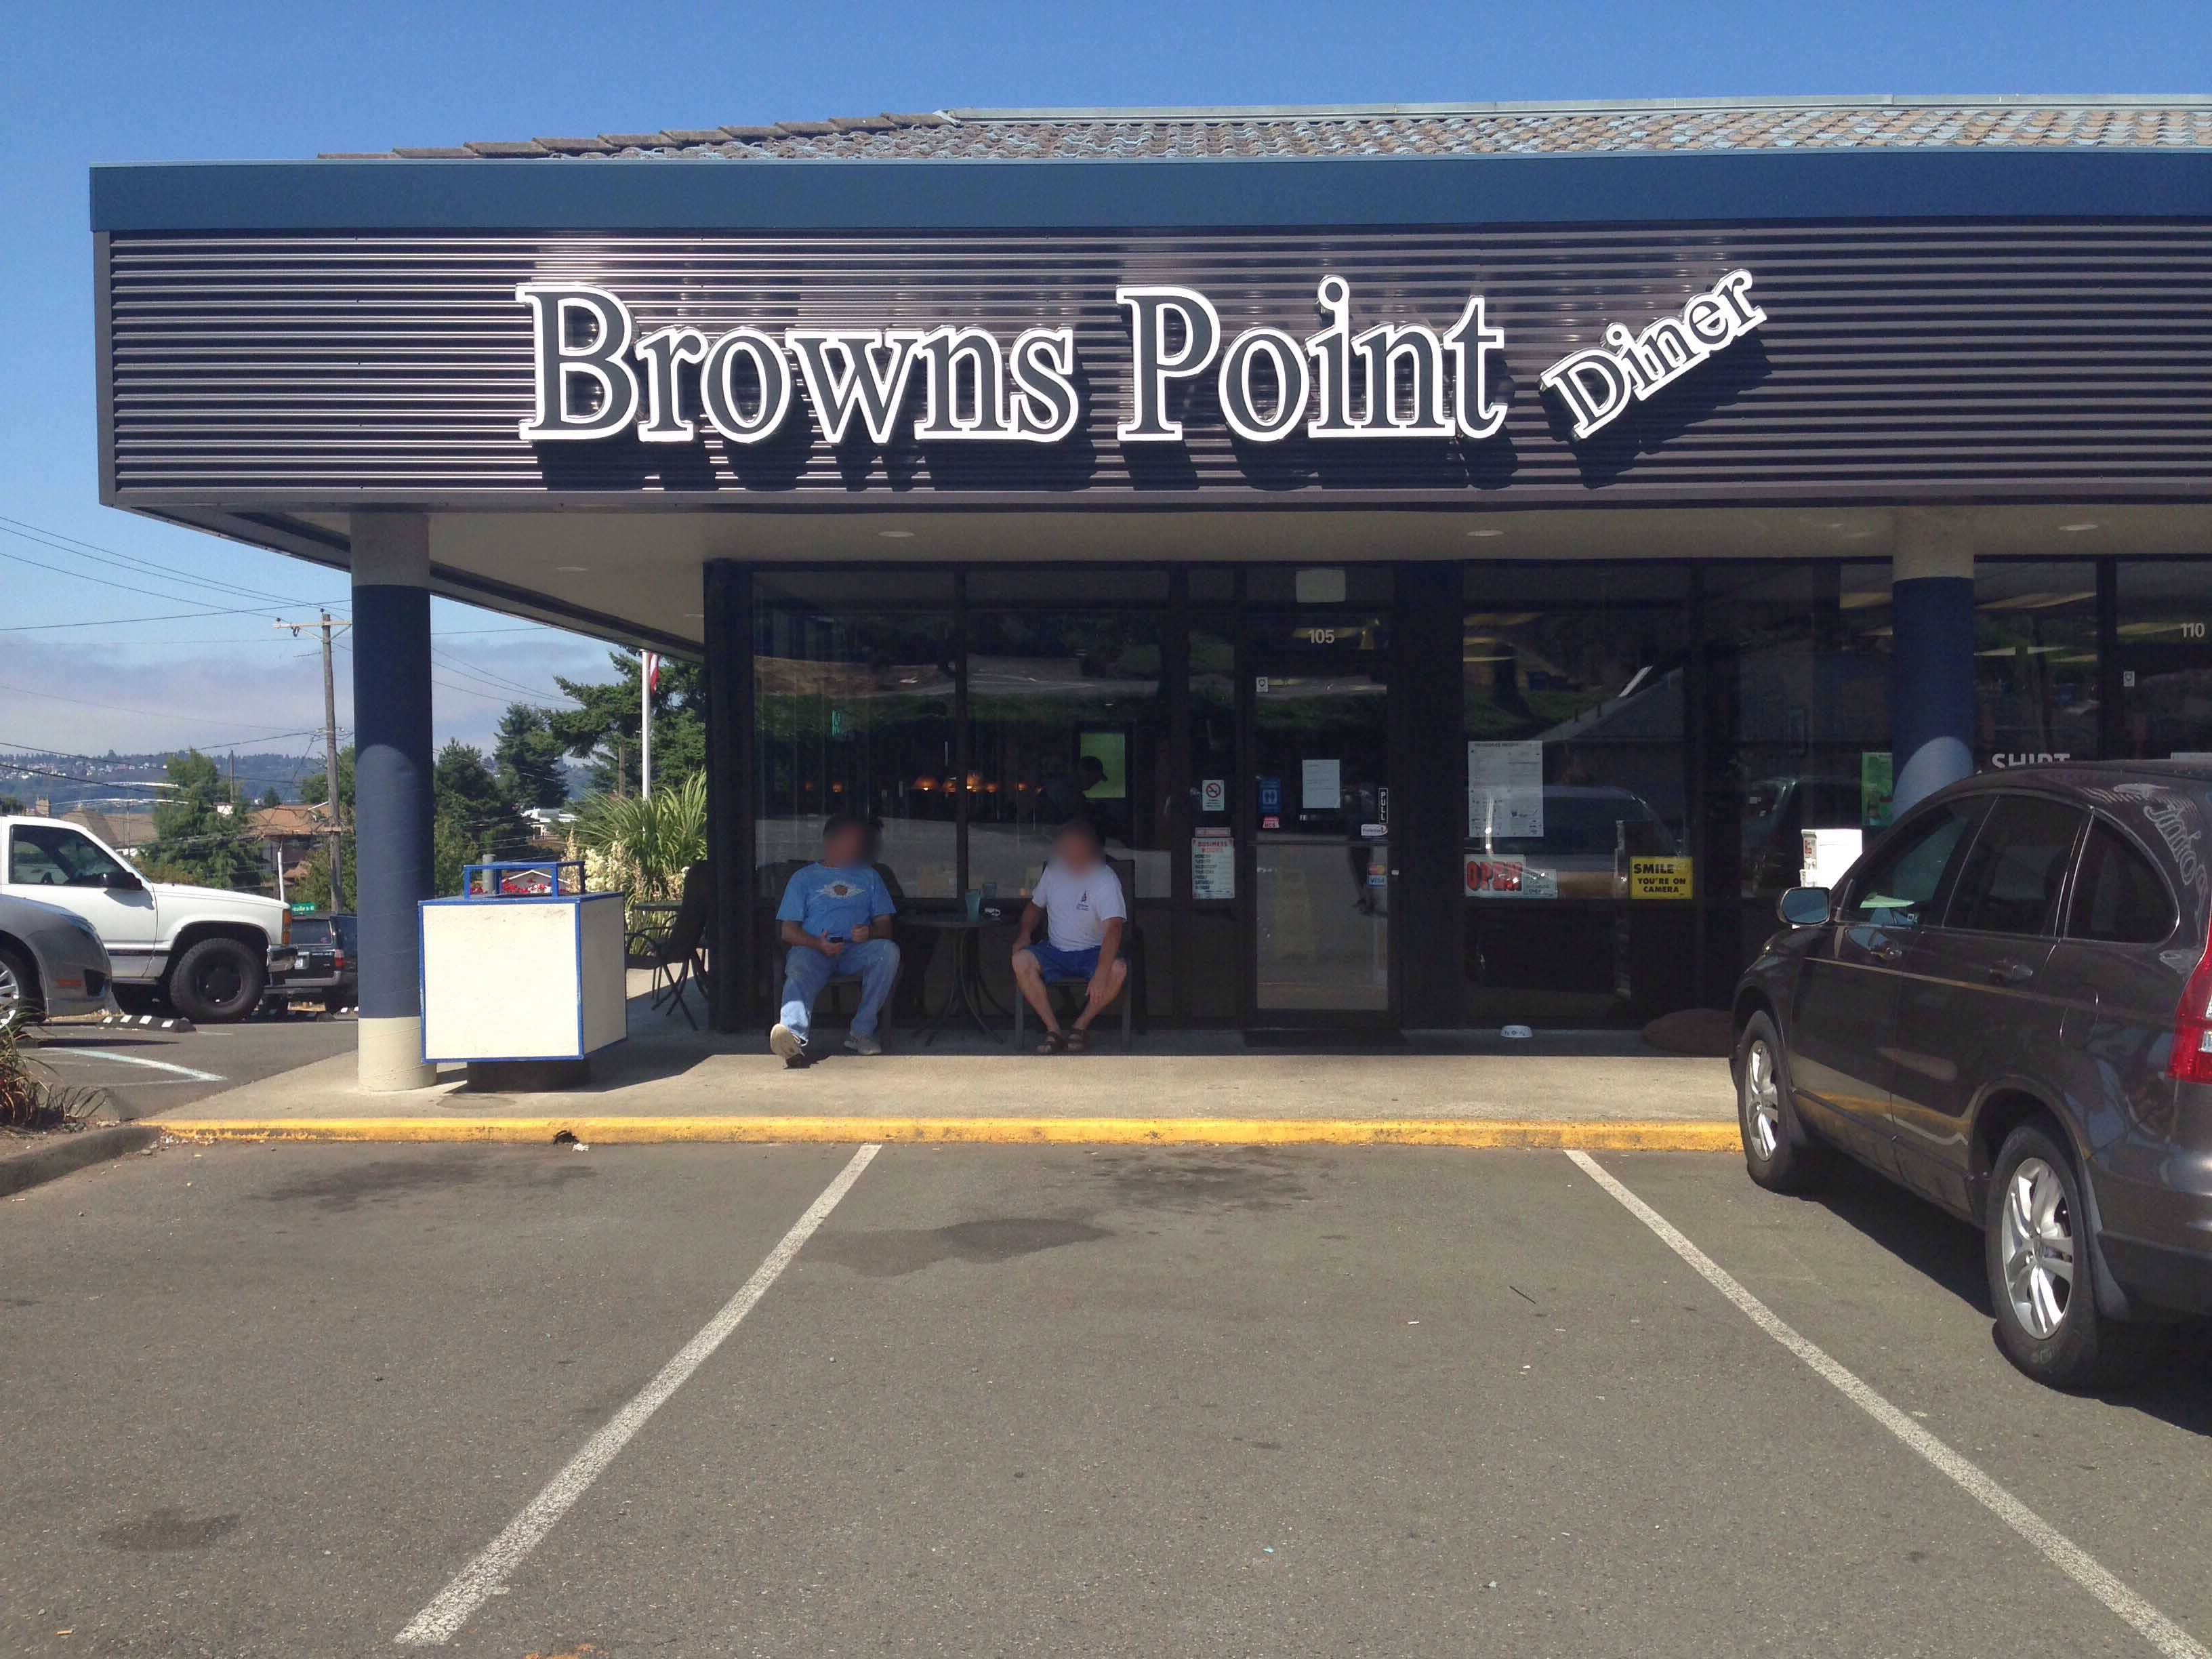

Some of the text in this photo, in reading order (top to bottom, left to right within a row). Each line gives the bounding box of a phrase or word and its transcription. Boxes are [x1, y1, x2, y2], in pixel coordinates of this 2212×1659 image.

[516, 275, 1508, 444] Browns Point
[1540, 268, 1767, 439] Diner
[1307, 629, 1335, 644] 105
[2180, 622, 2205, 638] 110
[1467, 861, 1523, 891] OPEN
[1633, 863, 1674, 874] SMILE
